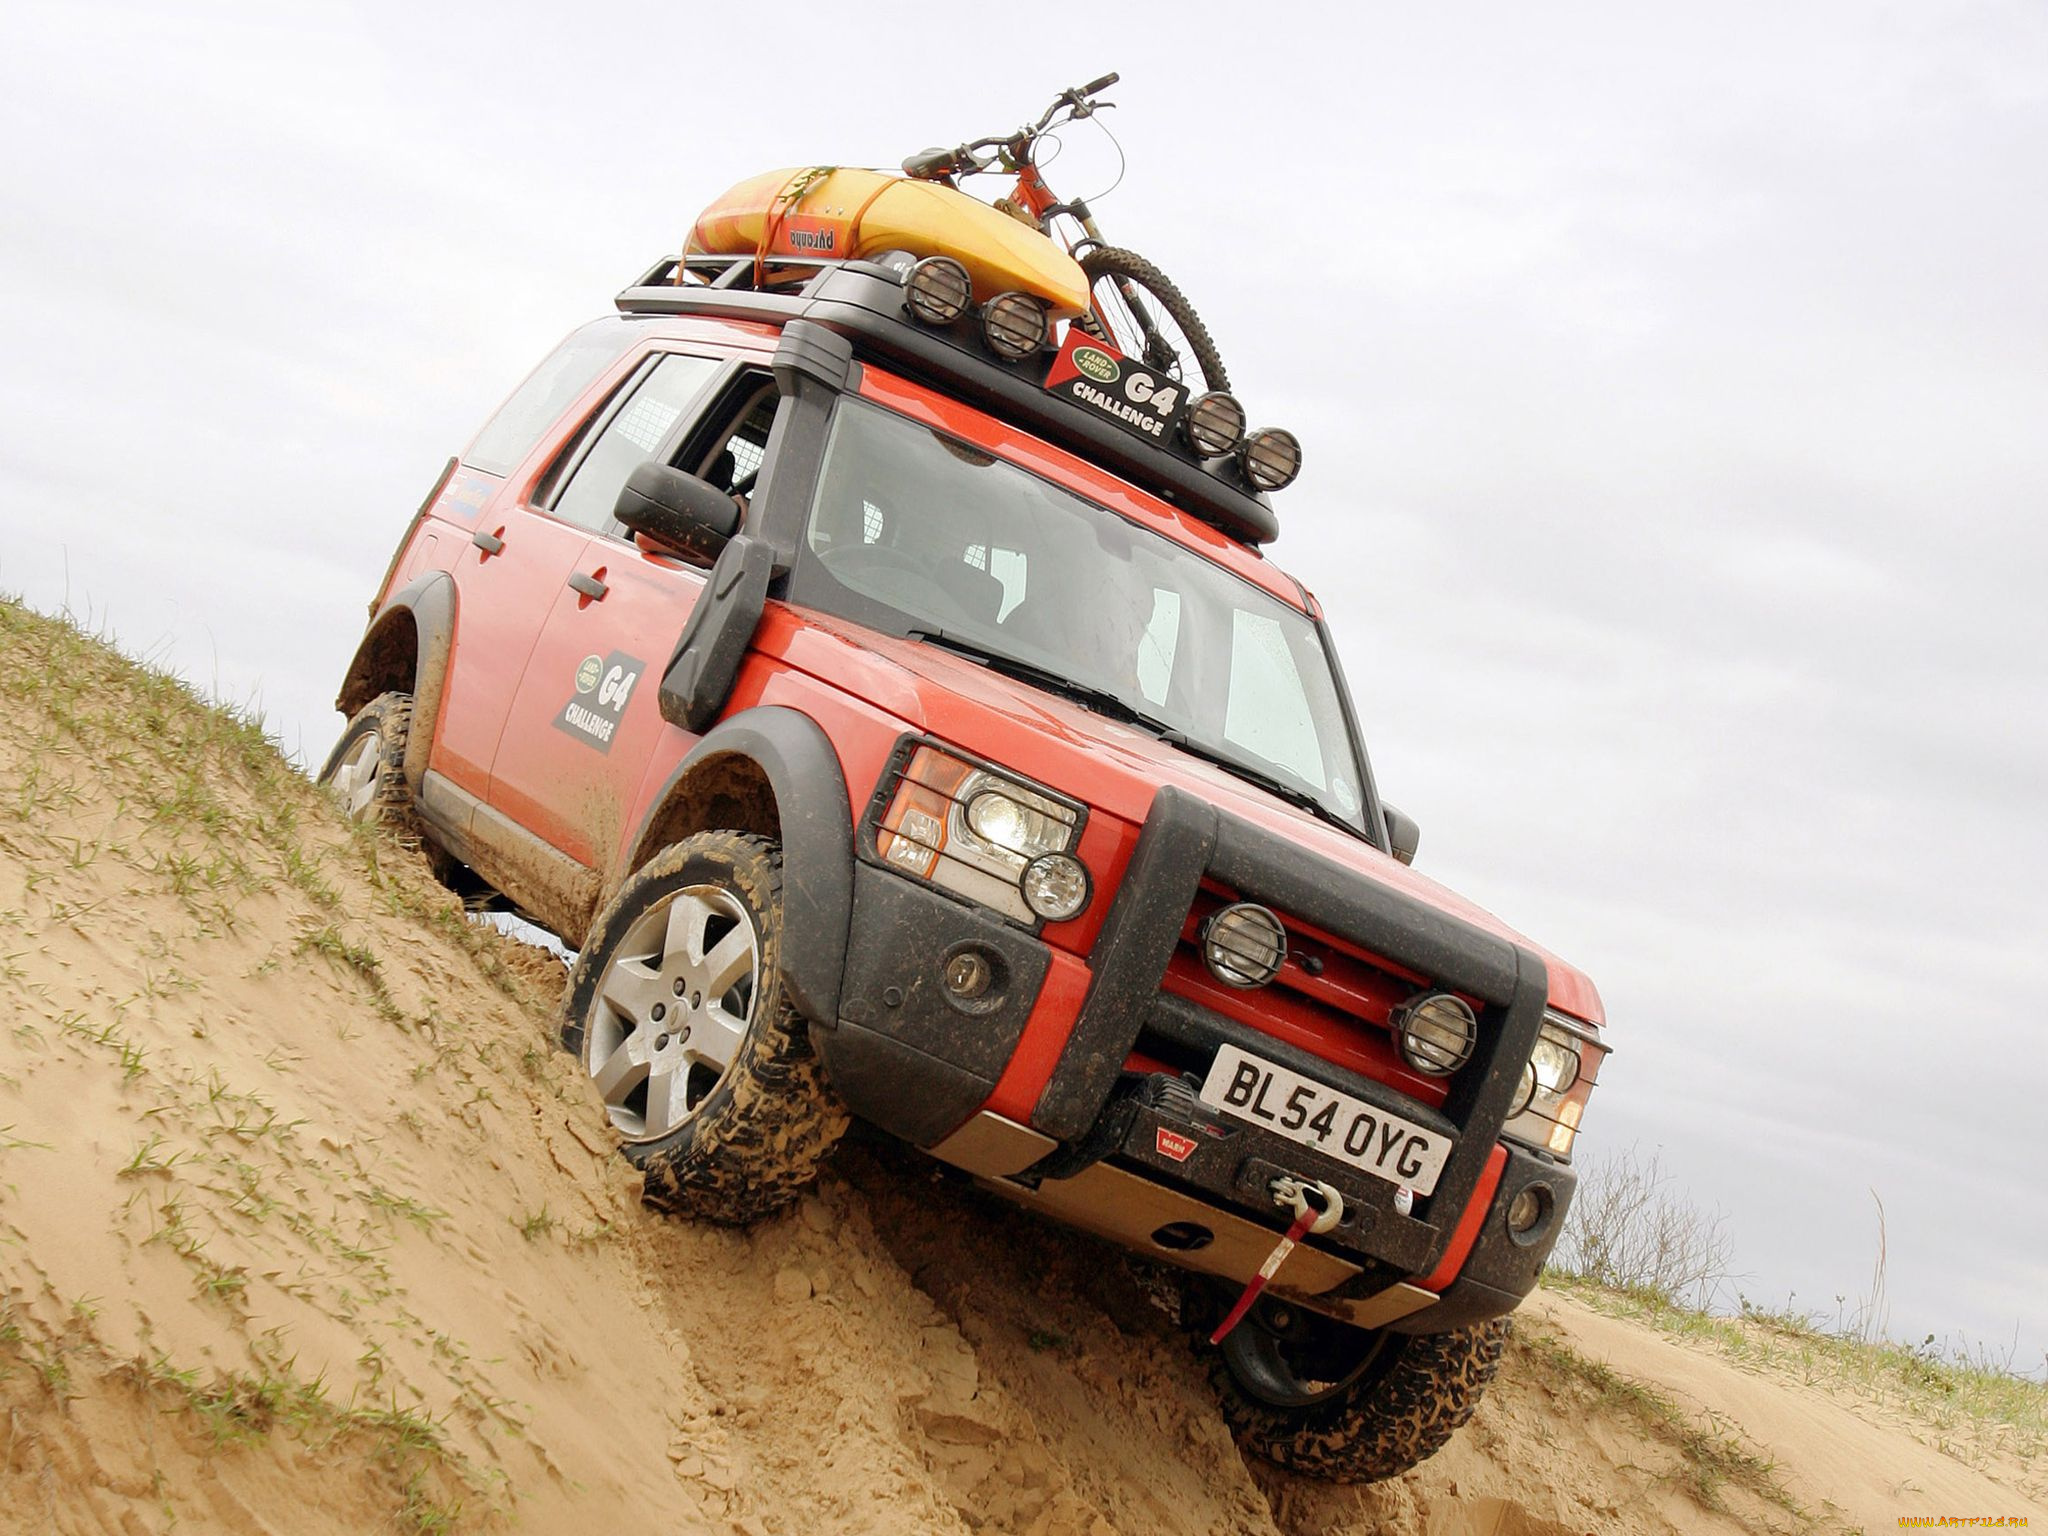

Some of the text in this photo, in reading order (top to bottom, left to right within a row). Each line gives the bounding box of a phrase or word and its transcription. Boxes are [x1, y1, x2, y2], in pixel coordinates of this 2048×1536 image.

[790, 229, 833, 251] pyranha
[1082, 361, 1112, 380] ROVER
[1083, 351, 1107, 367] LAND
[1072, 382, 1165, 437] CHALLENGE
[1125, 372, 1179, 417] G4
[598, 665, 637, 712] G4
[565, 703, 615, 742] CHALLENGE
[1223, 1060, 1430, 1179] BL54 OYG
[1162, 1138, 1186, 1154] WARN
